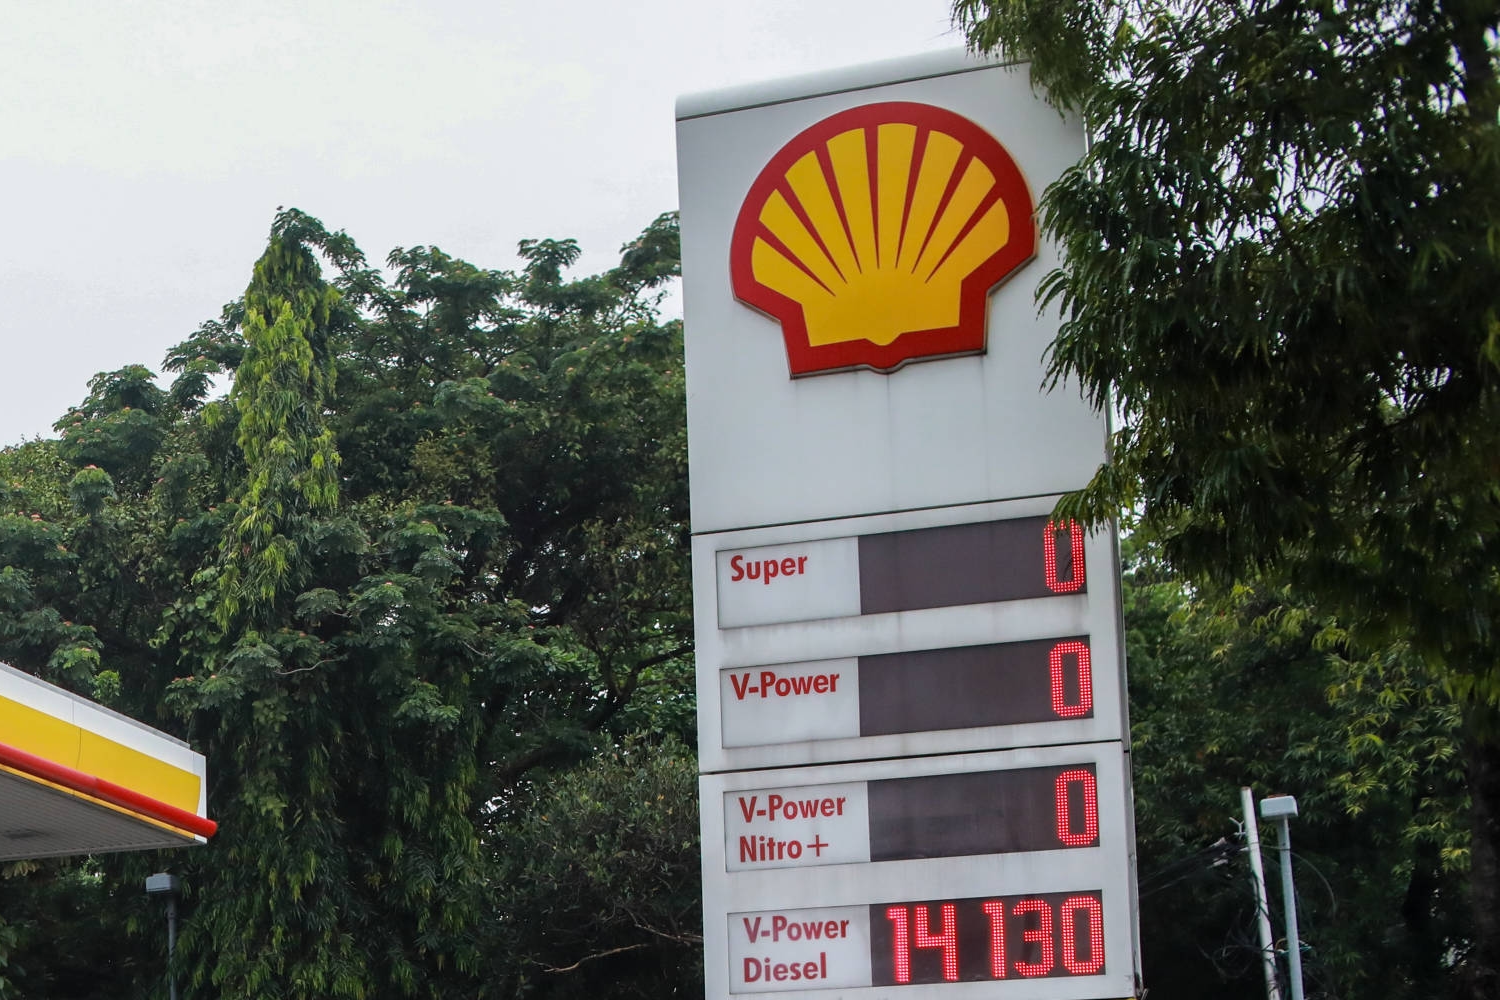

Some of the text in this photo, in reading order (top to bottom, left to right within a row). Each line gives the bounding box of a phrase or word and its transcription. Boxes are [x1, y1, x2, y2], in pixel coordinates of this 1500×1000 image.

[730, 554, 808, 585] Super
[1044, 517, 1085, 592] 0
[730, 671, 840, 701] V-Power
[1049, 641, 1092, 717] 0
[738, 795, 846, 824] V-Power
[1056, 769, 1098, 846] 0
[739, 834, 829, 863] Nitro+
[743, 916, 850, 944] V-Power
[743, 953, 827, 983] Diesel
